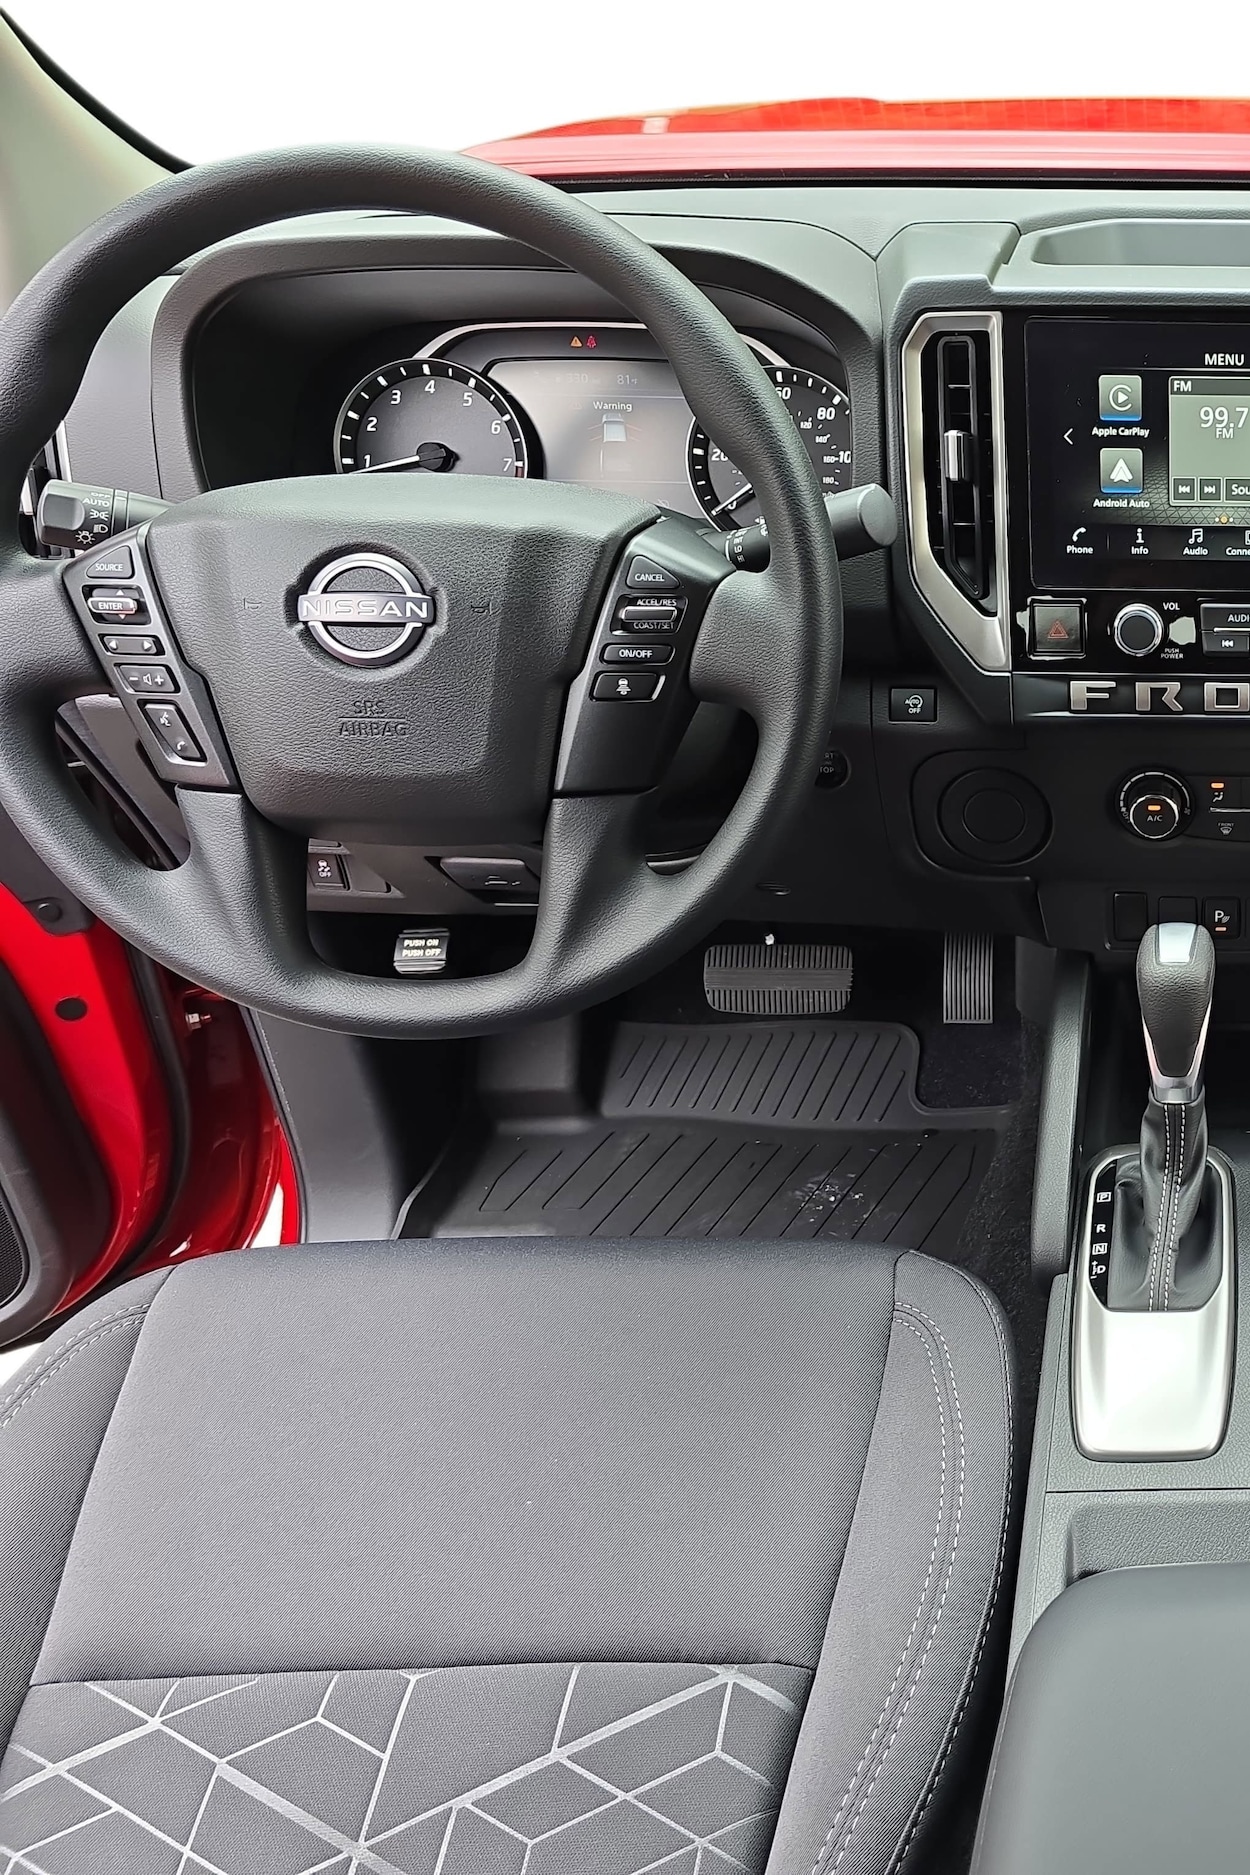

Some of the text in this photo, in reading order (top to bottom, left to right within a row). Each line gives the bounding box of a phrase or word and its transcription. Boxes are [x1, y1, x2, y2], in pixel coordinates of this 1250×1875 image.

[1204, 353, 1245, 366] MENU
[424, 380, 436, 394] 4
[1173, 381, 1193, 392] FM
[390, 390, 402, 405] 3
[462, 392, 473, 406] 5
[593, 401, 633, 412] Warning
[816, 407, 836, 420] 80
[1199, 406, 1250, 429] 99.7
[366, 417, 378, 432] 2
[490, 420, 501, 434] 6
[1091, 427, 1150, 439] Apple CarPlay
[1215, 428, 1235, 440] FM
[363, 454, 371, 469] 1
[502, 458, 513, 472] 7
[82, 497, 110, 507] AUTO
[1093, 498, 1150, 509] Android Auto
[734, 544, 742, 554] LO
[1066, 545, 1094, 555] Phone
[1130, 545, 1149, 555] Info
[1182, 546, 1209, 556] Audio
[95, 562, 124, 572] SOURCE
[634, 573, 665, 582] CANCEL
[97, 601, 123, 611] ENTER
[636, 598, 677, 606] ACCEL/RES
[1162, 602, 1181, 611] VOL
[302, 600, 428, 619] NISSAN
[633, 622, 674, 630] COAST/SET
[618, 649, 653, 658] ON/OFF
[353, 701, 385, 715] SRS
[339, 721, 408, 738] AIRBAG
[403, 939, 440, 948] PUSH ON
[401, 948, 442, 958] PUSH OFF
[1096, 1223, 1106, 1234] R
[1095, 1245, 1105, 1253] N
